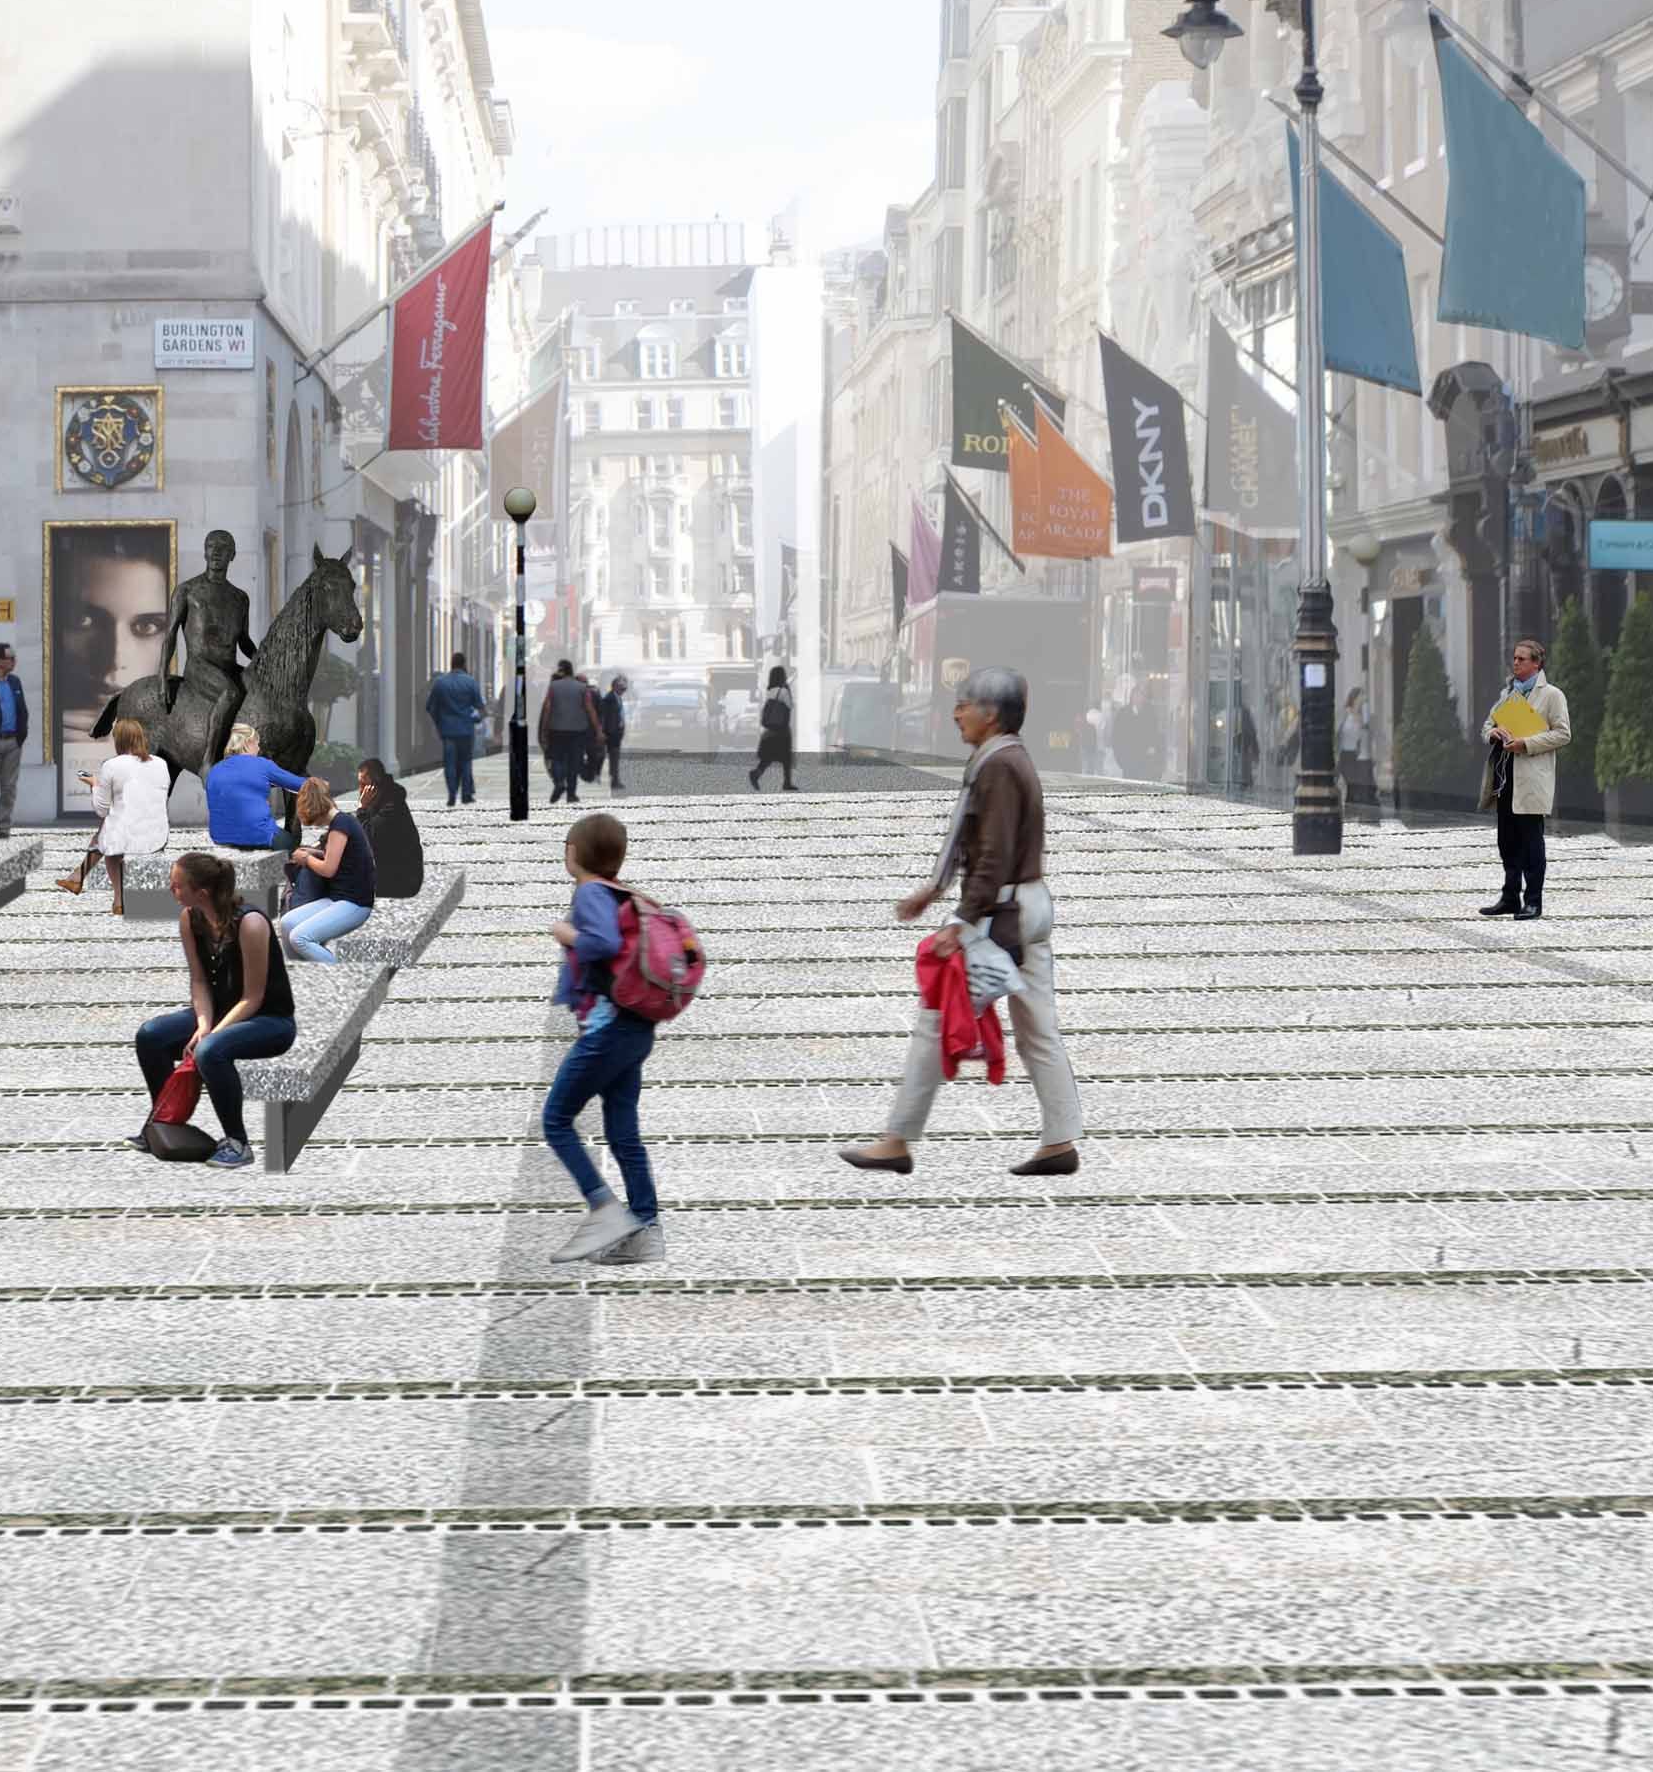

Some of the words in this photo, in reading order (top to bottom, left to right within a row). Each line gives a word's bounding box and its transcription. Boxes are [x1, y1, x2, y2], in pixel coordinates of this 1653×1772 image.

[420, 272, 458, 369] Ferragamo
[162, 323, 244, 337] BURLINGTON
[162, 339, 223, 352] GARDENS
[227, 339, 246, 352] W1
[418, 372, 442, 446] Salvatore
[1132, 397, 1168, 528] DKNY
[1058, 488, 1090, 503] THE
[1049, 504, 1099, 521] ROYAL
[1043, 523, 1105, 538] ARCADE
